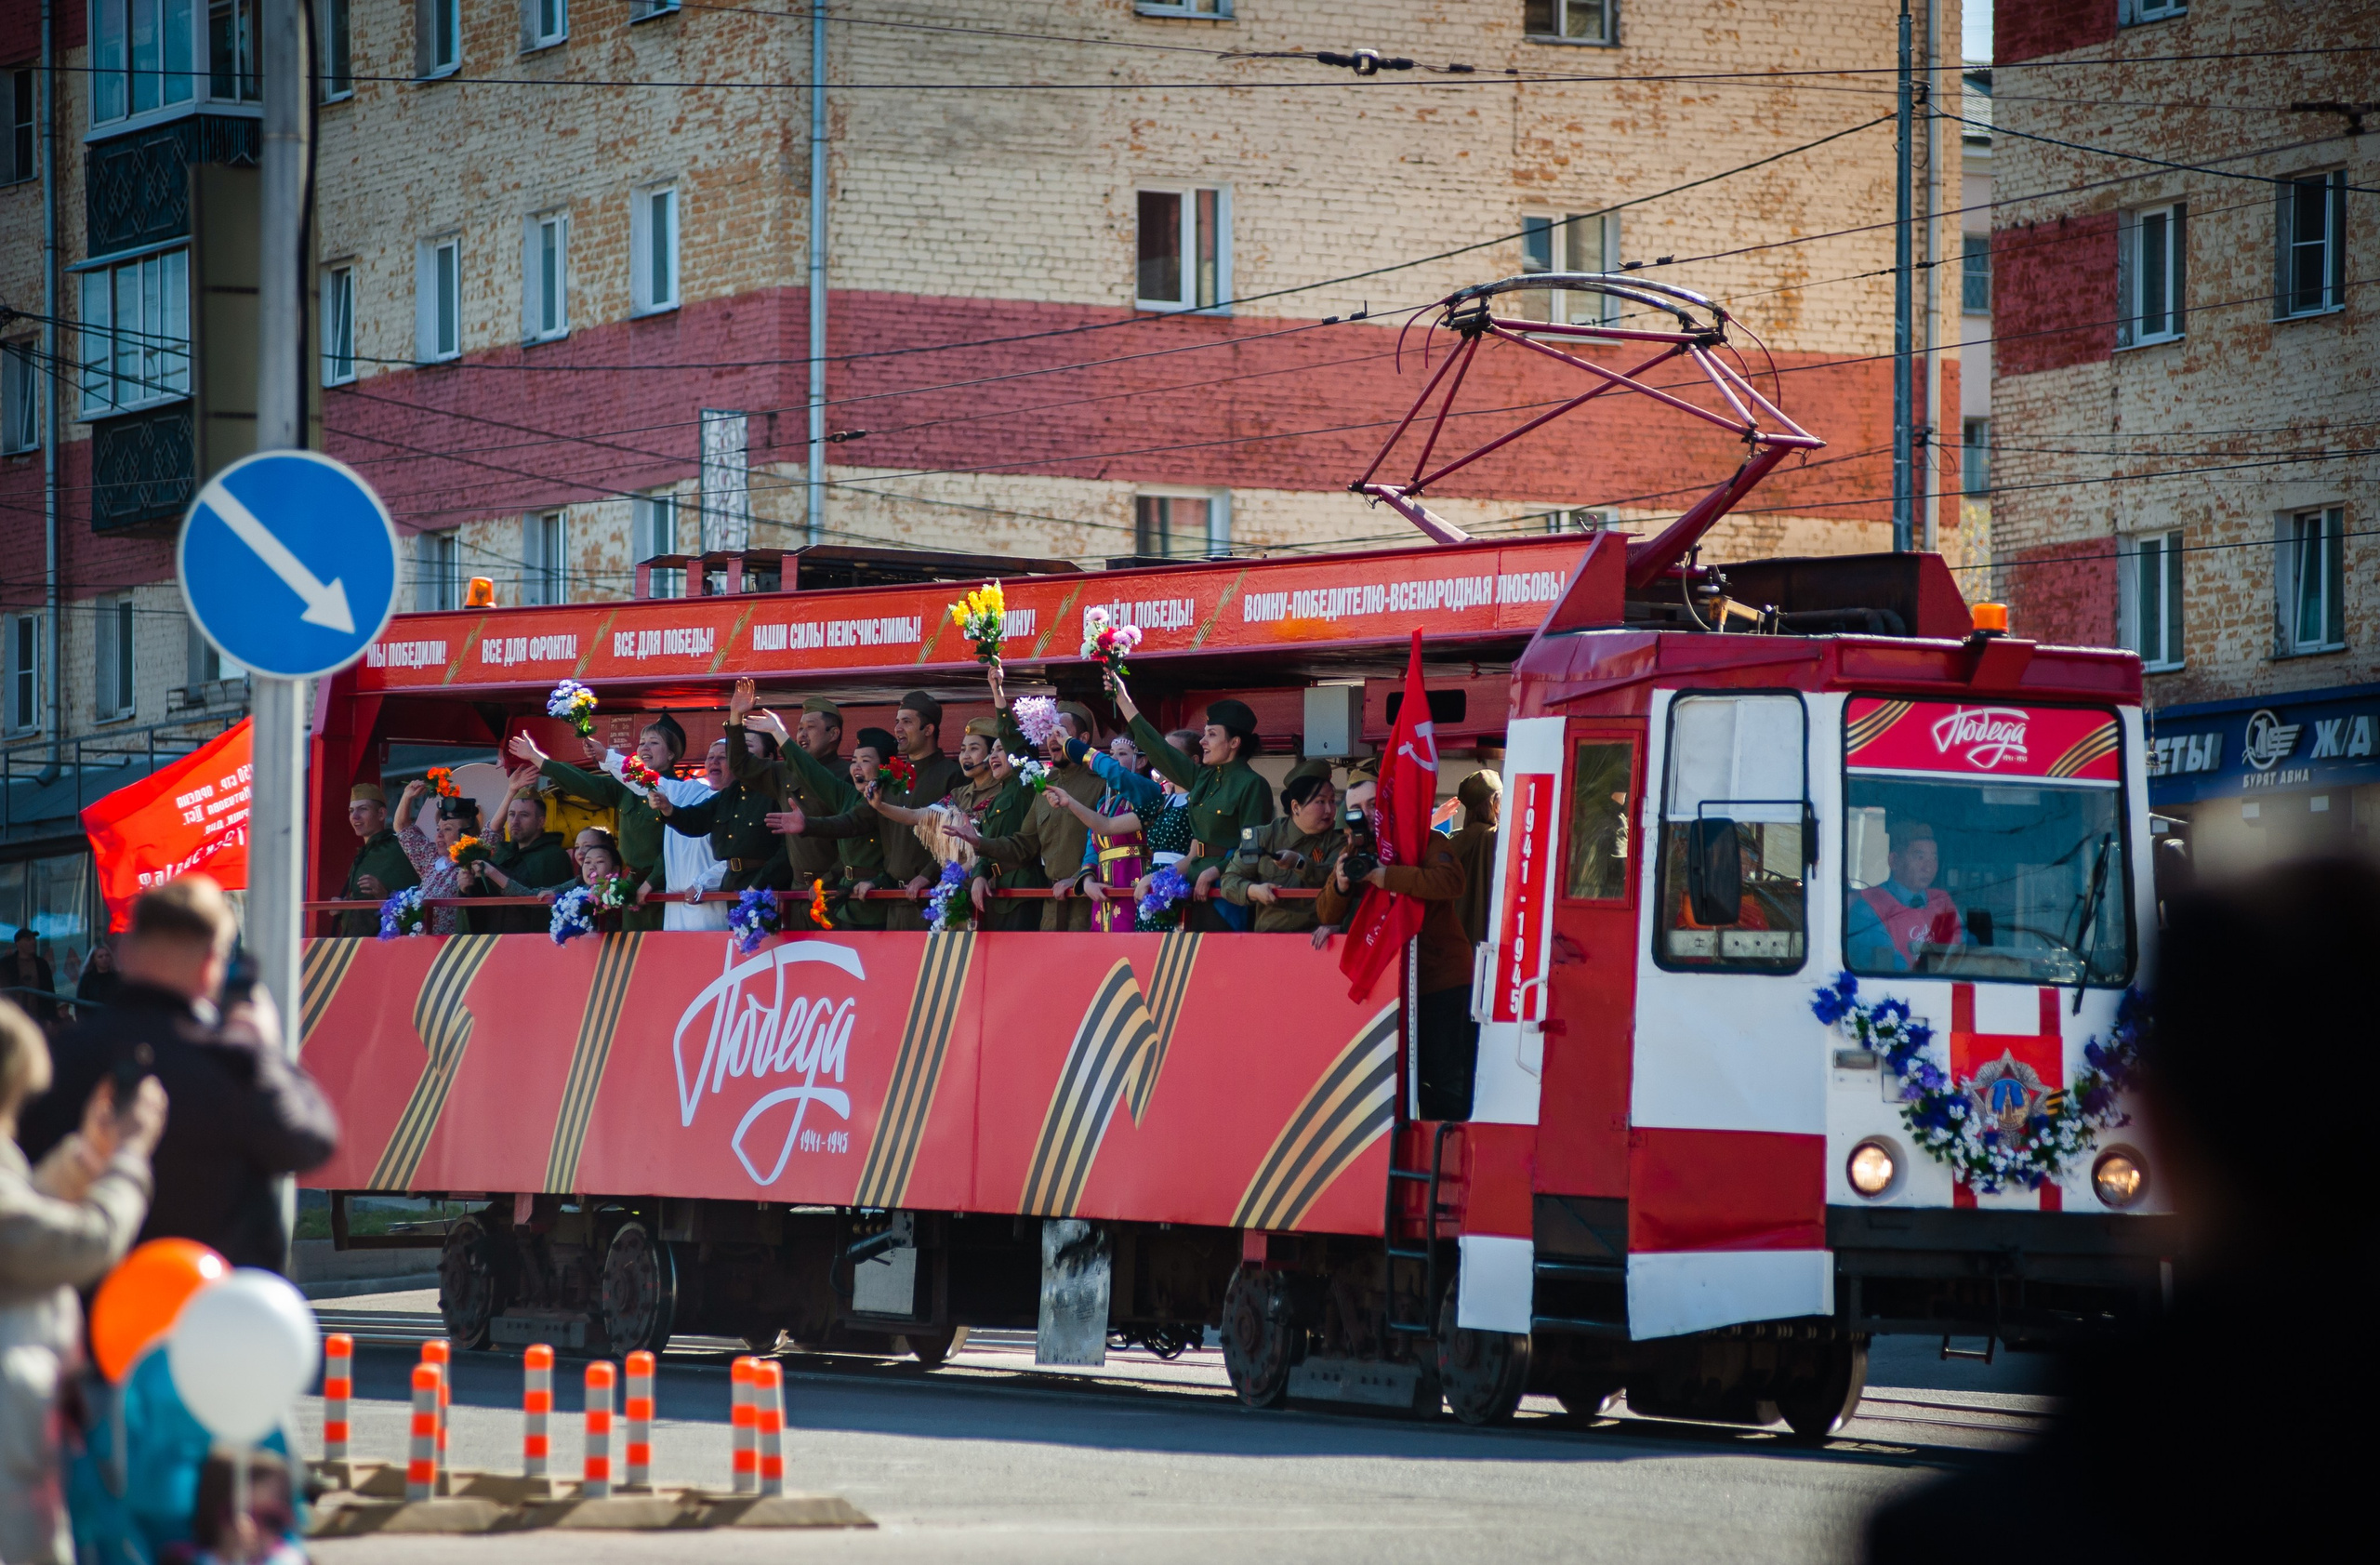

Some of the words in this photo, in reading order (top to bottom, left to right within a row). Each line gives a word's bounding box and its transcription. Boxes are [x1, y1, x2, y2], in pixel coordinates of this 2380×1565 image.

[1496, 570, 1566, 603] ЛЮБОВЬ!
[982, 609, 1036, 642] ДИНУ!
[1134, 598, 1194, 632] ПОБЕДЫ!
[615, 631, 634, 657] ВСЕ
[637, 630, 660, 660] ДЛЯ
[664, 627, 714, 657] ПОБЕДЫ!
[753, 623, 787, 651] НАШИ
[790, 621, 824, 649] СИЛЫ
[827, 616, 921, 647] НЕИСЧИСЛИМЫ!
[388, 641, 446, 670] ПОБЕДИЛИ!
[482, 638, 502, 664] ВСЕ
[504, 637, 527, 667] ДЛЯ
[529, 634, 576, 661] ФРОНТА!
[1932, 705, 2030, 768] Победа
[2310, 713, 2373, 758] Ж/Д
[2145, 733, 2223, 776] ЕТЫ
[2242, 771, 2277, 789] БУРЯТ
[2280, 768, 2309, 785] АВИА
[673, 938, 866, 1186] Победа
[800, 1129, 848, 1153] 1941-1945
